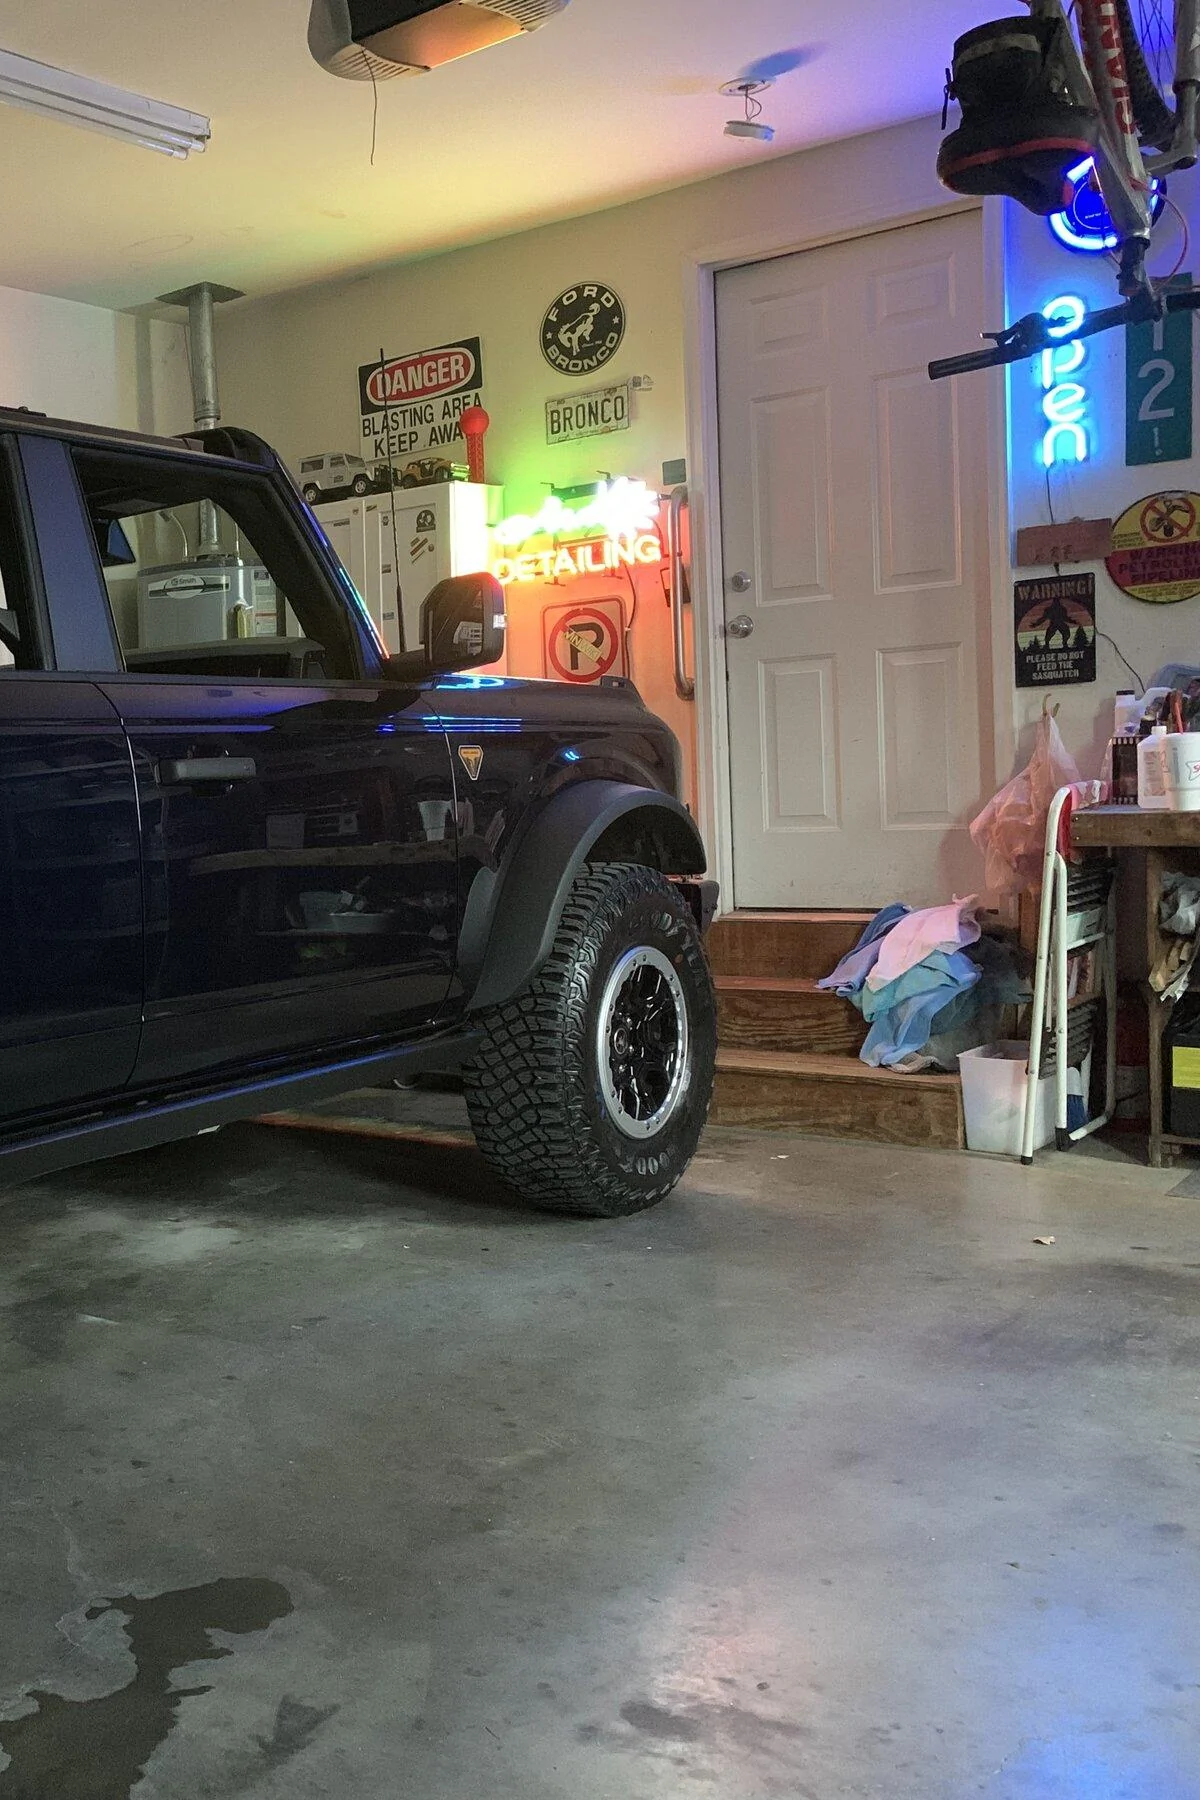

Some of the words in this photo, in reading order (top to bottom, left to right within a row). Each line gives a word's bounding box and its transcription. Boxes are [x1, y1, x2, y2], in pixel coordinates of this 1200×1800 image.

[547, 285, 616, 322] FORD
[546, 332, 619, 371] BRONCO
[375, 353, 465, 399] DANGER
[362, 404, 434, 438] BLASTING
[441, 392, 483, 421] AREA
[550, 396, 624, 435] BRONCO
[374, 431, 419, 458] KEEP
[428, 421, 464, 446] AWA
[494, 534, 662, 584] DETAILING
[1130, 543, 1200, 559] WARNIN
[1017, 579, 1093, 600] WARNING!
[1132, 567, 1200, 583] PIPELIN
[1026, 652, 1057, 664] PLEASE
[1057, 651, 1068, 662] DO
[1068, 650, 1085, 660] NOT
[1031, 668, 1080, 680] SASQUATCH
[1036, 662, 1057, 671] FEED
[1058, 660, 1075, 669] THE
